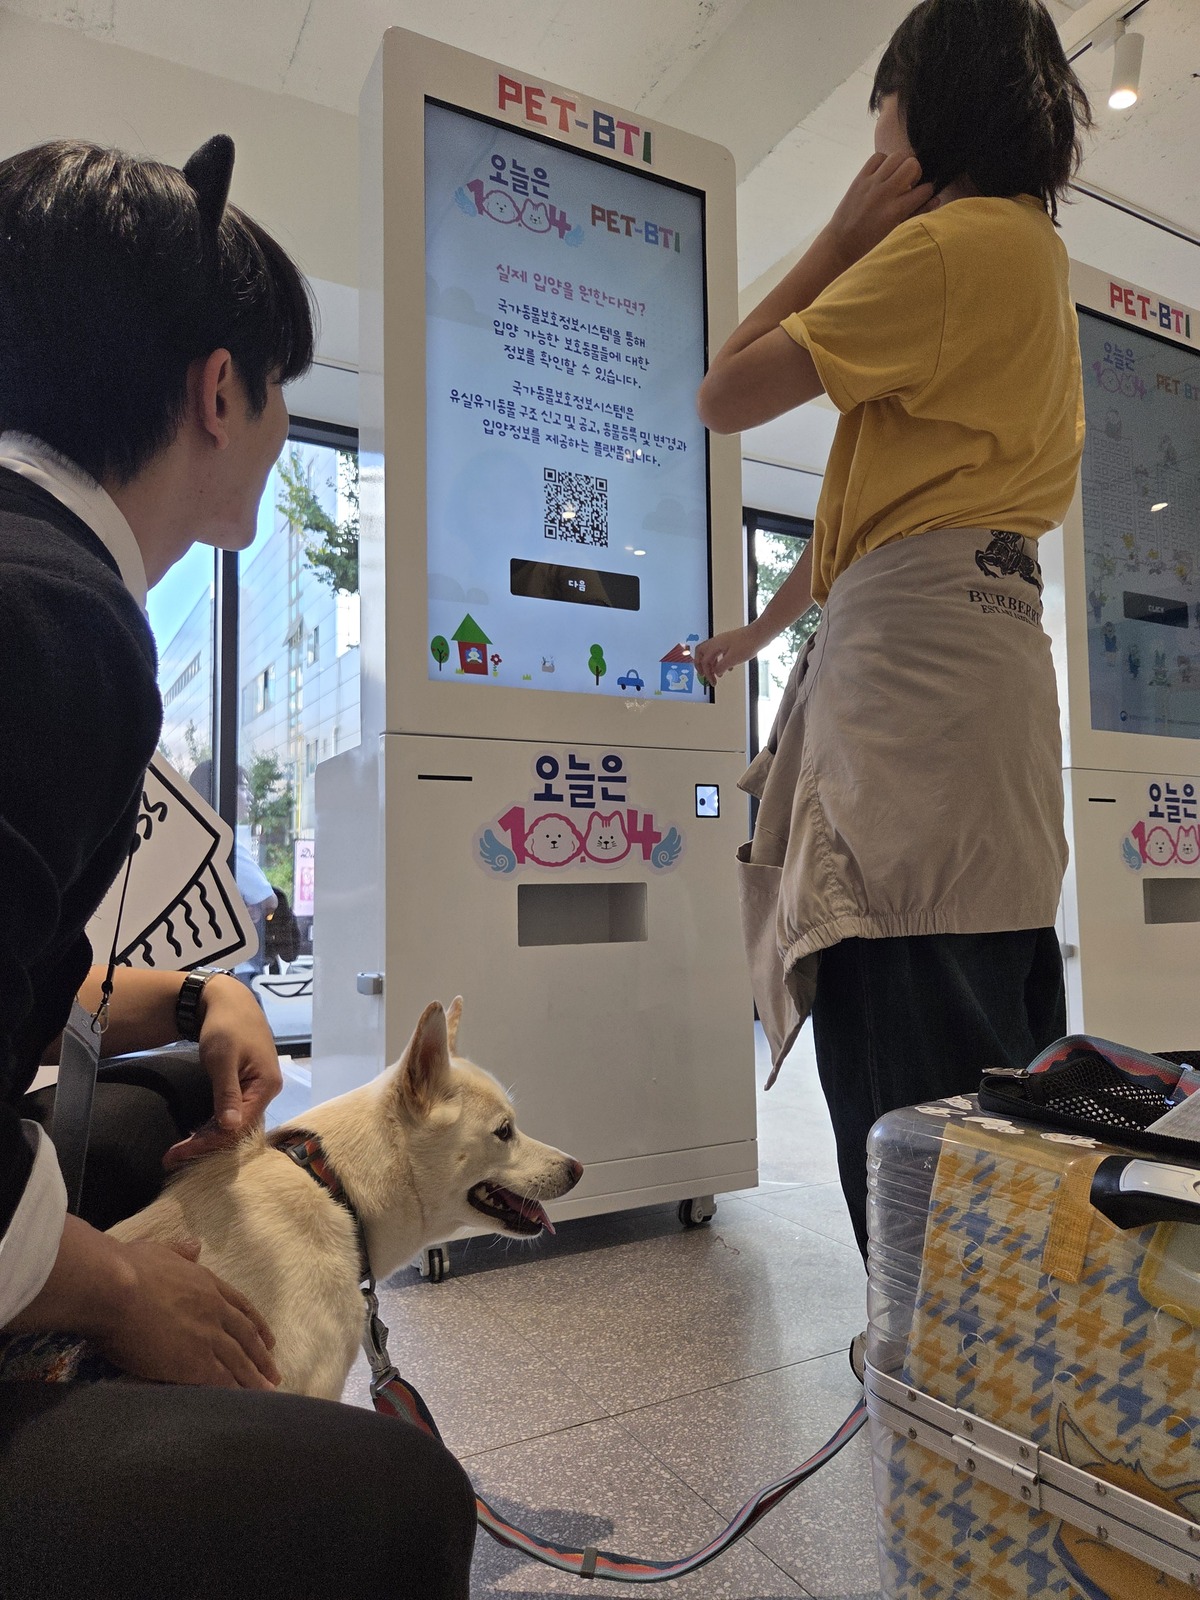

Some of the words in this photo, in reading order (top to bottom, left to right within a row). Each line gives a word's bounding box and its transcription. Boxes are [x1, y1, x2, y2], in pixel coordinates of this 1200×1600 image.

[498, 74, 652, 165] PET-BTI
[489, 154, 551, 199] 오늘은
[591, 204, 681, 253] PET-BTI
[496, 264, 528, 283] 실제
[533, 273, 574, 301] 입양을
[579, 285, 646, 317] 원한다면?
[1110, 282, 1190, 339] PET-BTI
[493, 319, 519, 338] 입양
[523, 330, 560, 348] 가능한
[564, 337, 622, 363] 보호동물들에
[625, 355, 650, 371] 대한
[498, 298, 621, 345] 국가동물보호정보시스템을
[625, 331, 646, 348] 통해
[504, 344, 535, 366] 정보를
[540, 351, 577, 376] 확인할
[581, 363, 591, 376] 수
[595, 367, 642, 389] 있습니다.
[1103, 342, 1135, 371] 오늘은
[449, 389, 516, 420] 유실유기동물
[603, 422, 638, 443] 동물등록
[512, 380, 635, 421] 국가동물보호정보시스템은
[482, 419, 541, 445] 입양정보를
[545, 434, 590, 453] 제공하는
[594, 441, 661, 467] 플랫폼입니다.
[568, 579, 586, 592] 다음
[533, 754, 627, 809] 오늘은
[1149, 783, 1198, 823] 오늘은
